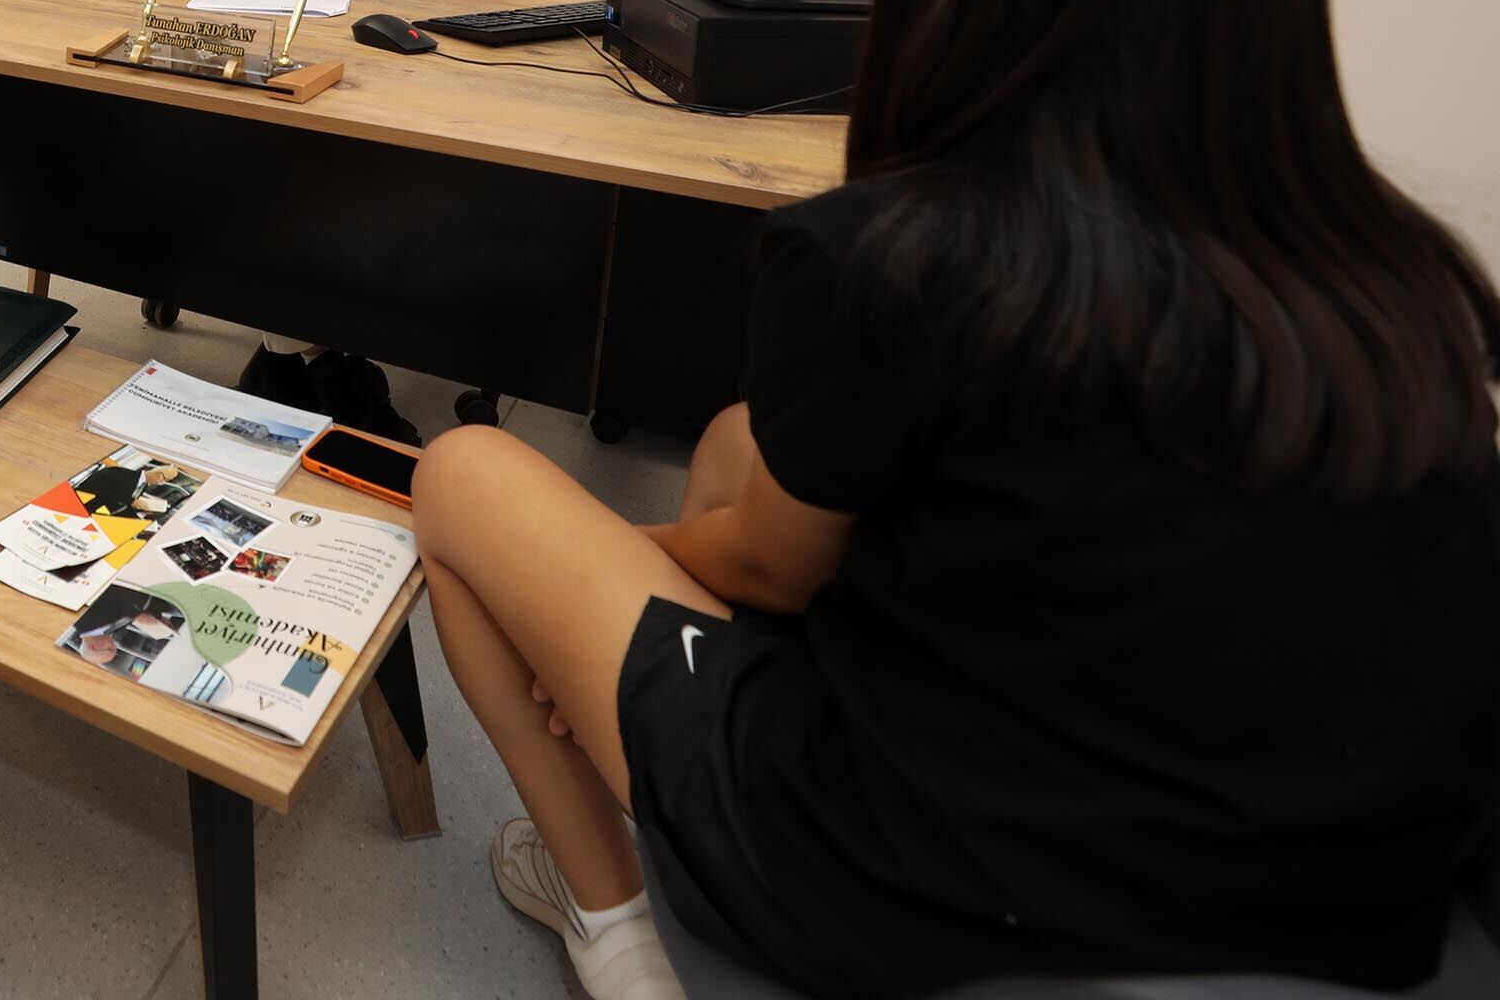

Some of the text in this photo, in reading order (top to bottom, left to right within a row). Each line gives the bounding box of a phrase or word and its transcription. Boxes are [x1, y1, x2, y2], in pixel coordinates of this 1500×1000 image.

[146, 15, 256, 43] Tunahan ERDOĞAN
[150, 32, 245, 56] Psikolojik Danışman
[207, 604, 343, 651] Akademisi
[195, 621, 330, 675] Cumhuriyet
